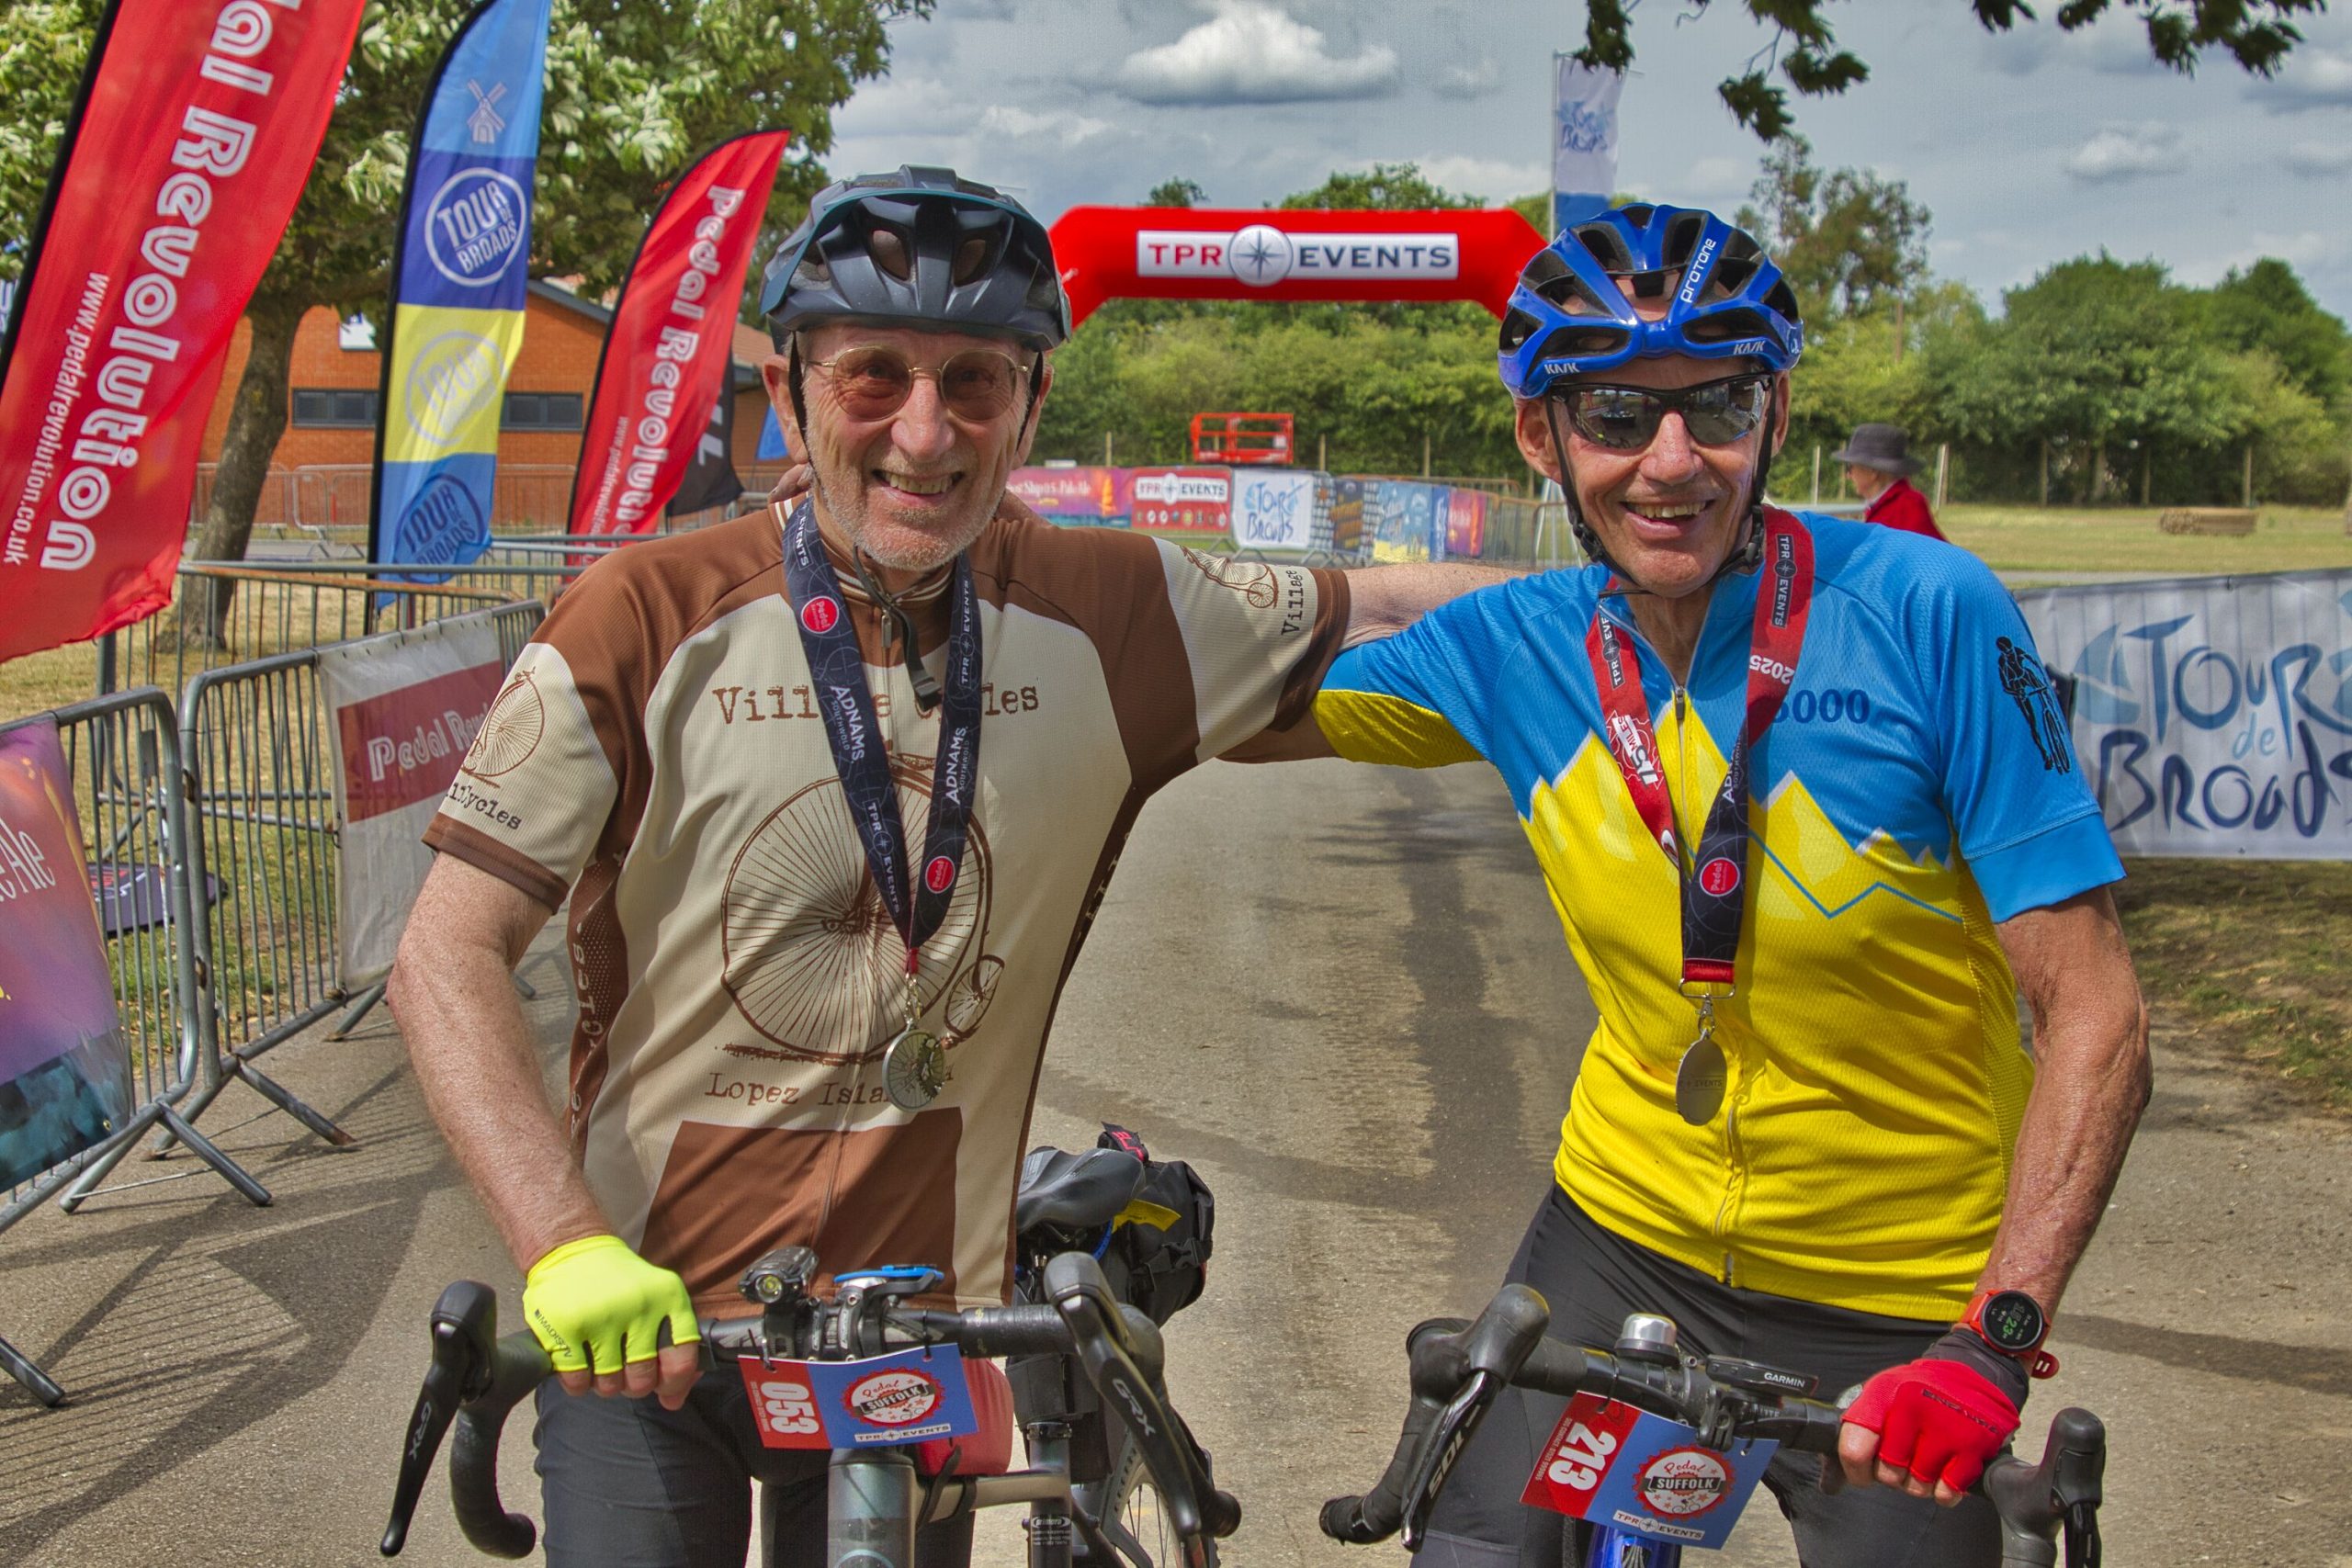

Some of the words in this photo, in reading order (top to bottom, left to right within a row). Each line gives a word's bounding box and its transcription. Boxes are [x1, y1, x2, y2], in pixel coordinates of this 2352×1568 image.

[436, 181, 510, 250] TOUR
[457, 220, 517, 274] BROADS
[672, 185, 746, 320] Pedal
[1148, 243, 1221, 265] TPR
[1299, 244, 1452, 268] EVENTS
[40, 106, 257, 570] Revolution
[3, 272, 109, 565] www.pedalrevolution.co.uk
[1139, 482, 1161, 494] TPR
[1182, 483, 1226, 496] EVENTS
[796, 516, 809, 567] EVENTS
[1780, 536, 1791, 559] TPR
[963, 579, 971, 634] EVENTS
[1774, 579, 1789, 626] EVENTS
[1601, 616, 1613, 640] EVE
[961, 657, 970, 684] TPR
[1611, 660, 1622, 685] TPR
[1750, 655, 1795, 685] 2025
[831, 699, 851, 750] SOUTHWOLD
[1617, 716, 1638, 753] MILES
[2231, 712, 2277, 760] de
[368, 718, 450, 782] Pedal
[866, 802, 882, 833] TPR
[883, 855, 900, 914] EVENTS
[705, 1072, 800, 1106] Lopez
[863, 1380, 900, 1399] Pedal
[867, 1387, 922, 1410] SUFFOLK
[1764, 1372, 1805, 1388] GARMIN
[760, 1382, 820, 1435] 053
[1112, 1378, 1156, 1436] GRX
[408, 1401, 433, 1460] GRX
[903, 1426, 950, 1437] EVENTS
[1549, 1422, 1617, 1490] 213
[1664, 1460, 1706, 1475] Pedal
[1657, 1476, 1714, 1490] SUFFOLK
[1617, 1513, 1641, 1526] TPR
[1658, 1526, 1703, 1540] EVENTS
